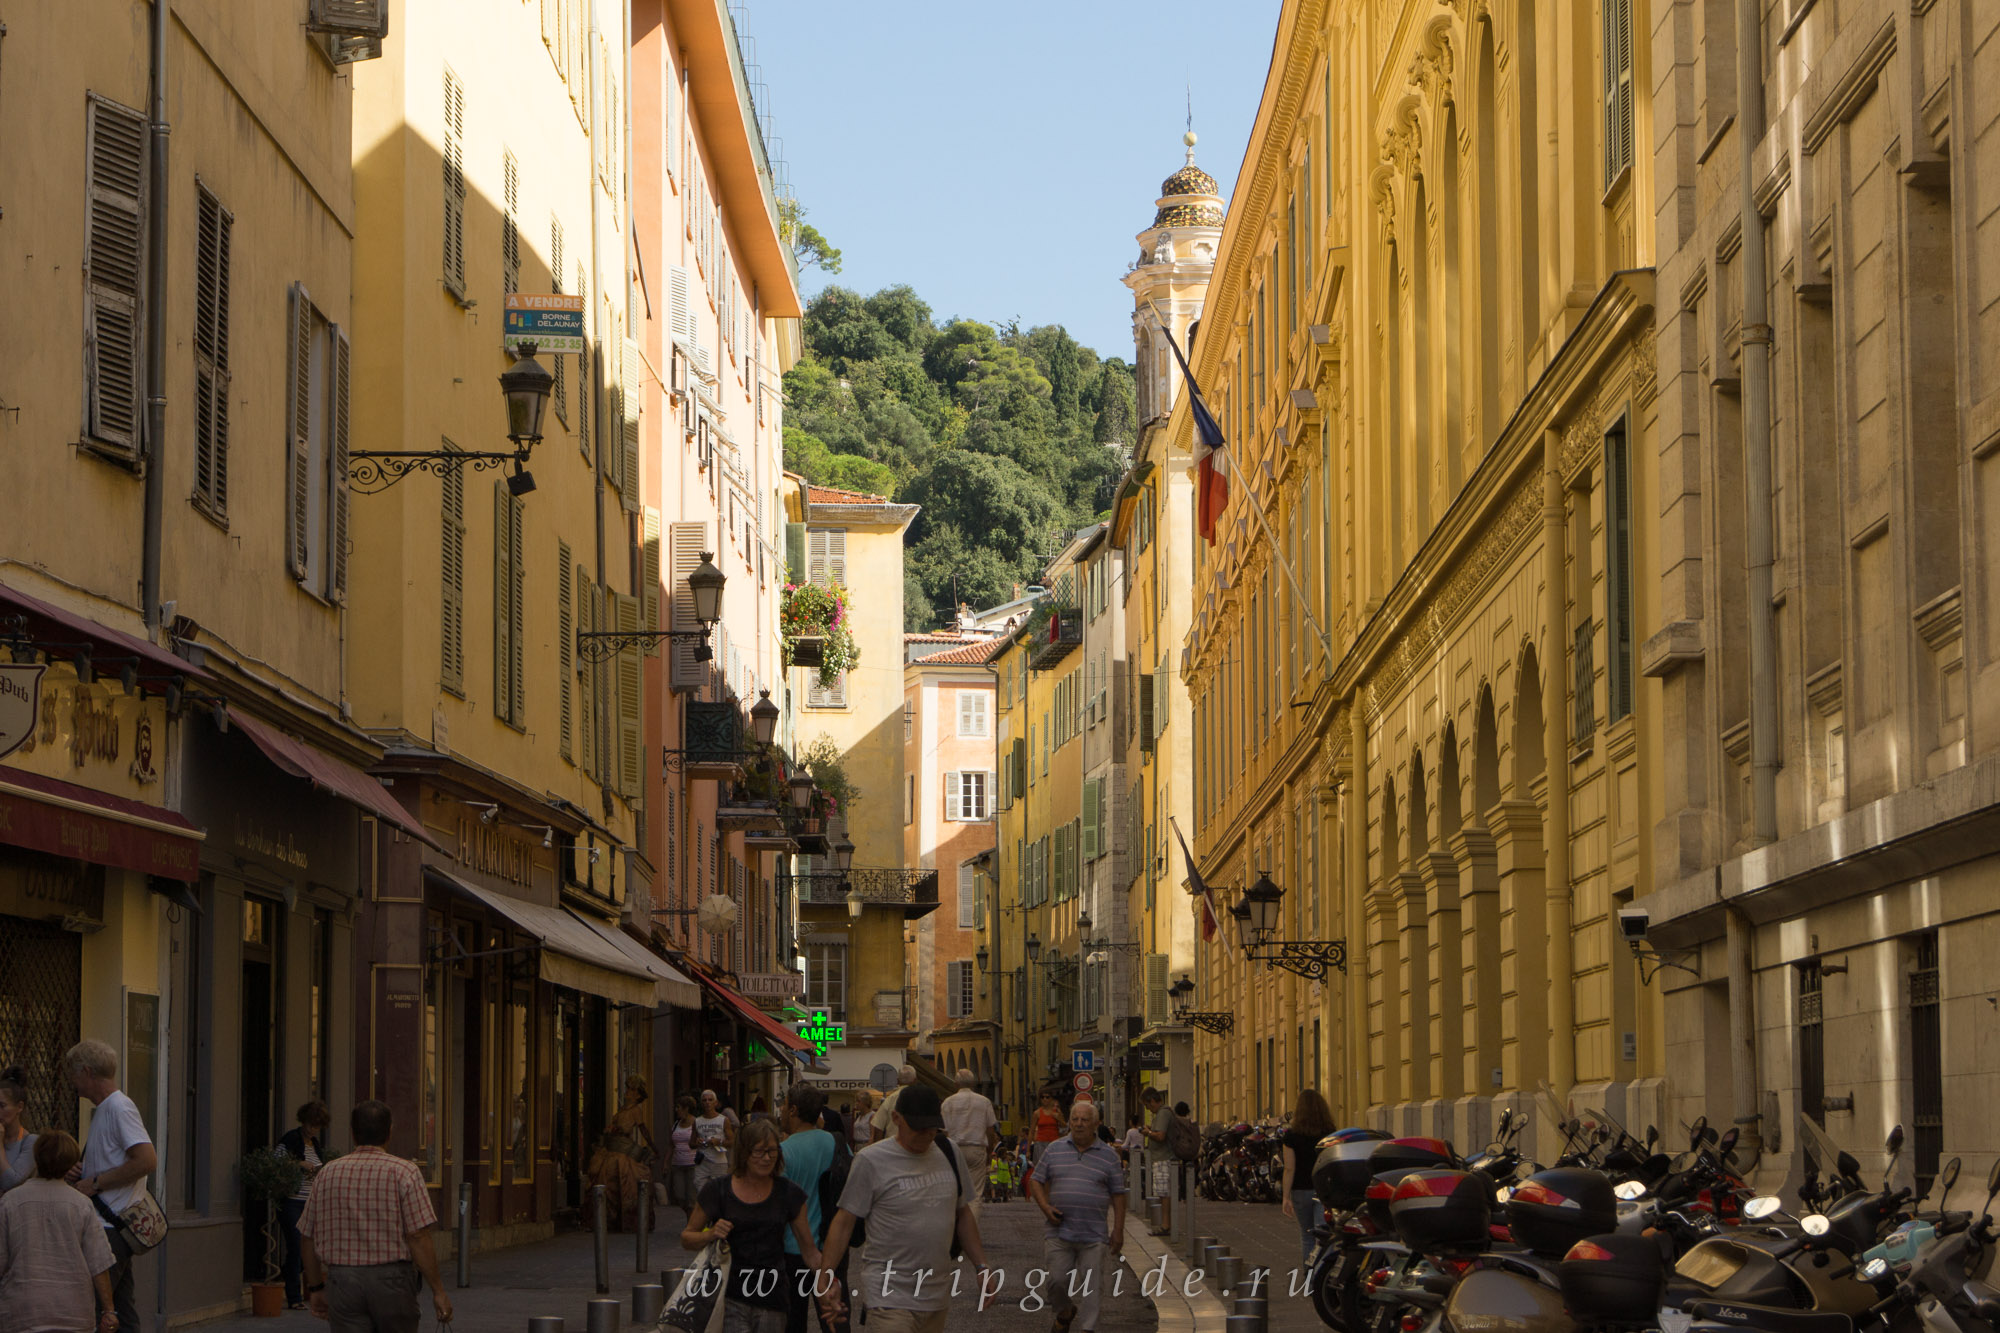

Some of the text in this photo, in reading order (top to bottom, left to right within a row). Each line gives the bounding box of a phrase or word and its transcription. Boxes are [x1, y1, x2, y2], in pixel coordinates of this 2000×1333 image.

[508, 296, 581, 309] A VENDRE
[541, 313, 571, 321] BORNE
[537, 320, 580, 328] DELAUNAY
[538, 338, 551, 348] 62
[553, 338, 566, 349] 25
[568, 339, 581, 349] 35
[741, 976, 799, 994] TOILETTAGE
[816, 1080, 873, 1090] La Taper
